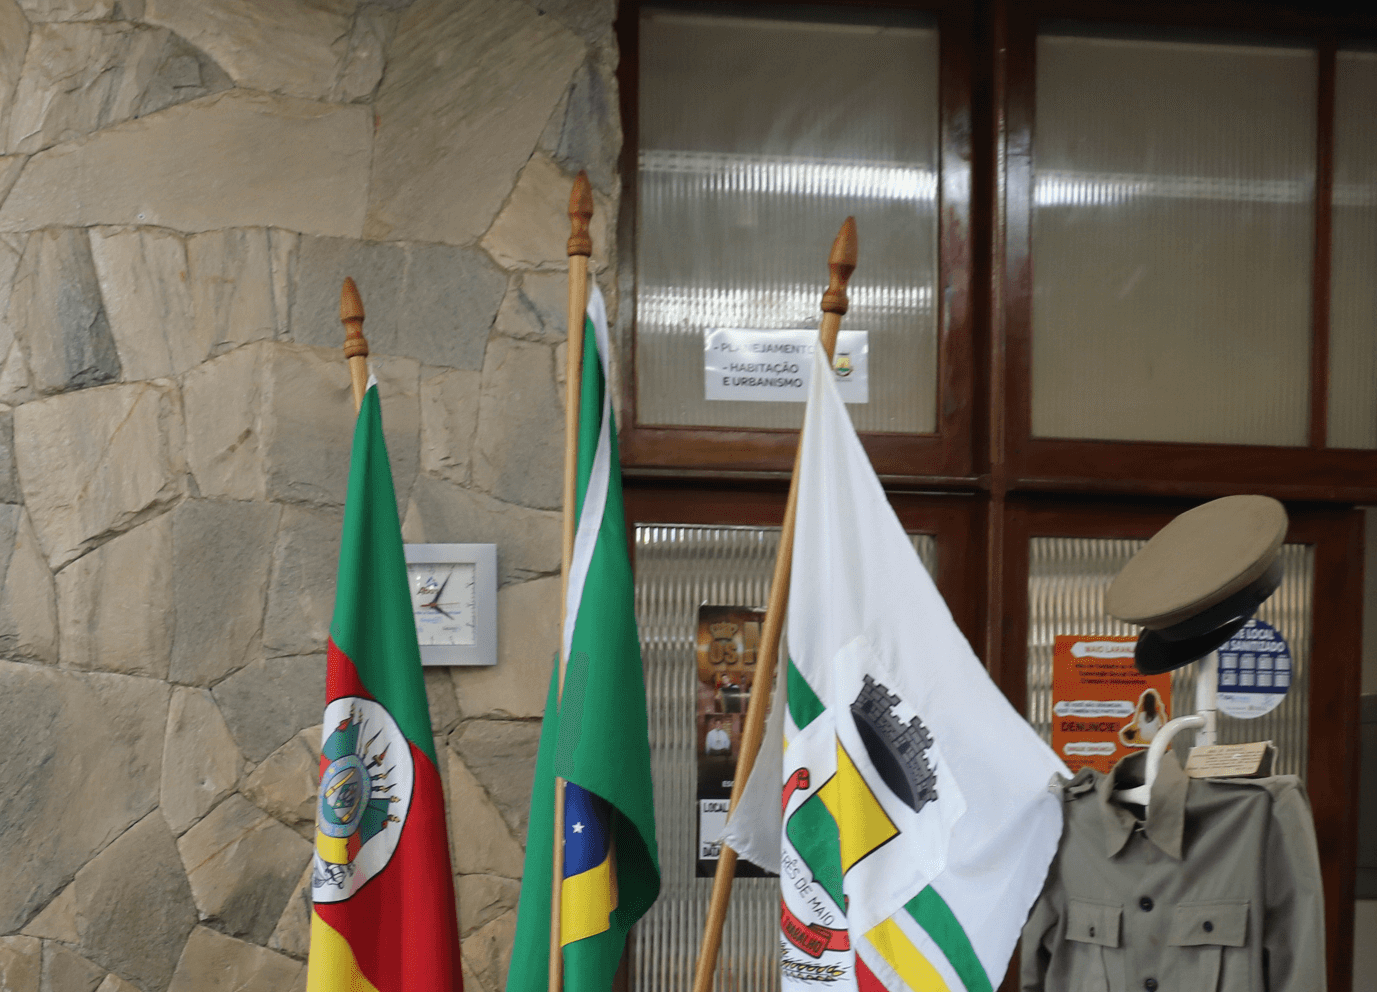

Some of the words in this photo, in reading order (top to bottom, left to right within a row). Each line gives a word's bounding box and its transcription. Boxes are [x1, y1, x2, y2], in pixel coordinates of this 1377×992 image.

[720, 342, 815, 354] PLEJAMENTO
[730, 361, 800, 376] HABITAÇÃO
[722, 376, 730, 386] E
[732, 377, 803, 388] URBANISMO
[1246, 628, 1275, 640] LOCAL
[703, 802, 729, 813] LOCAL
[794, 876, 814, 899] DE
[807, 896, 836, 927] MAIO
